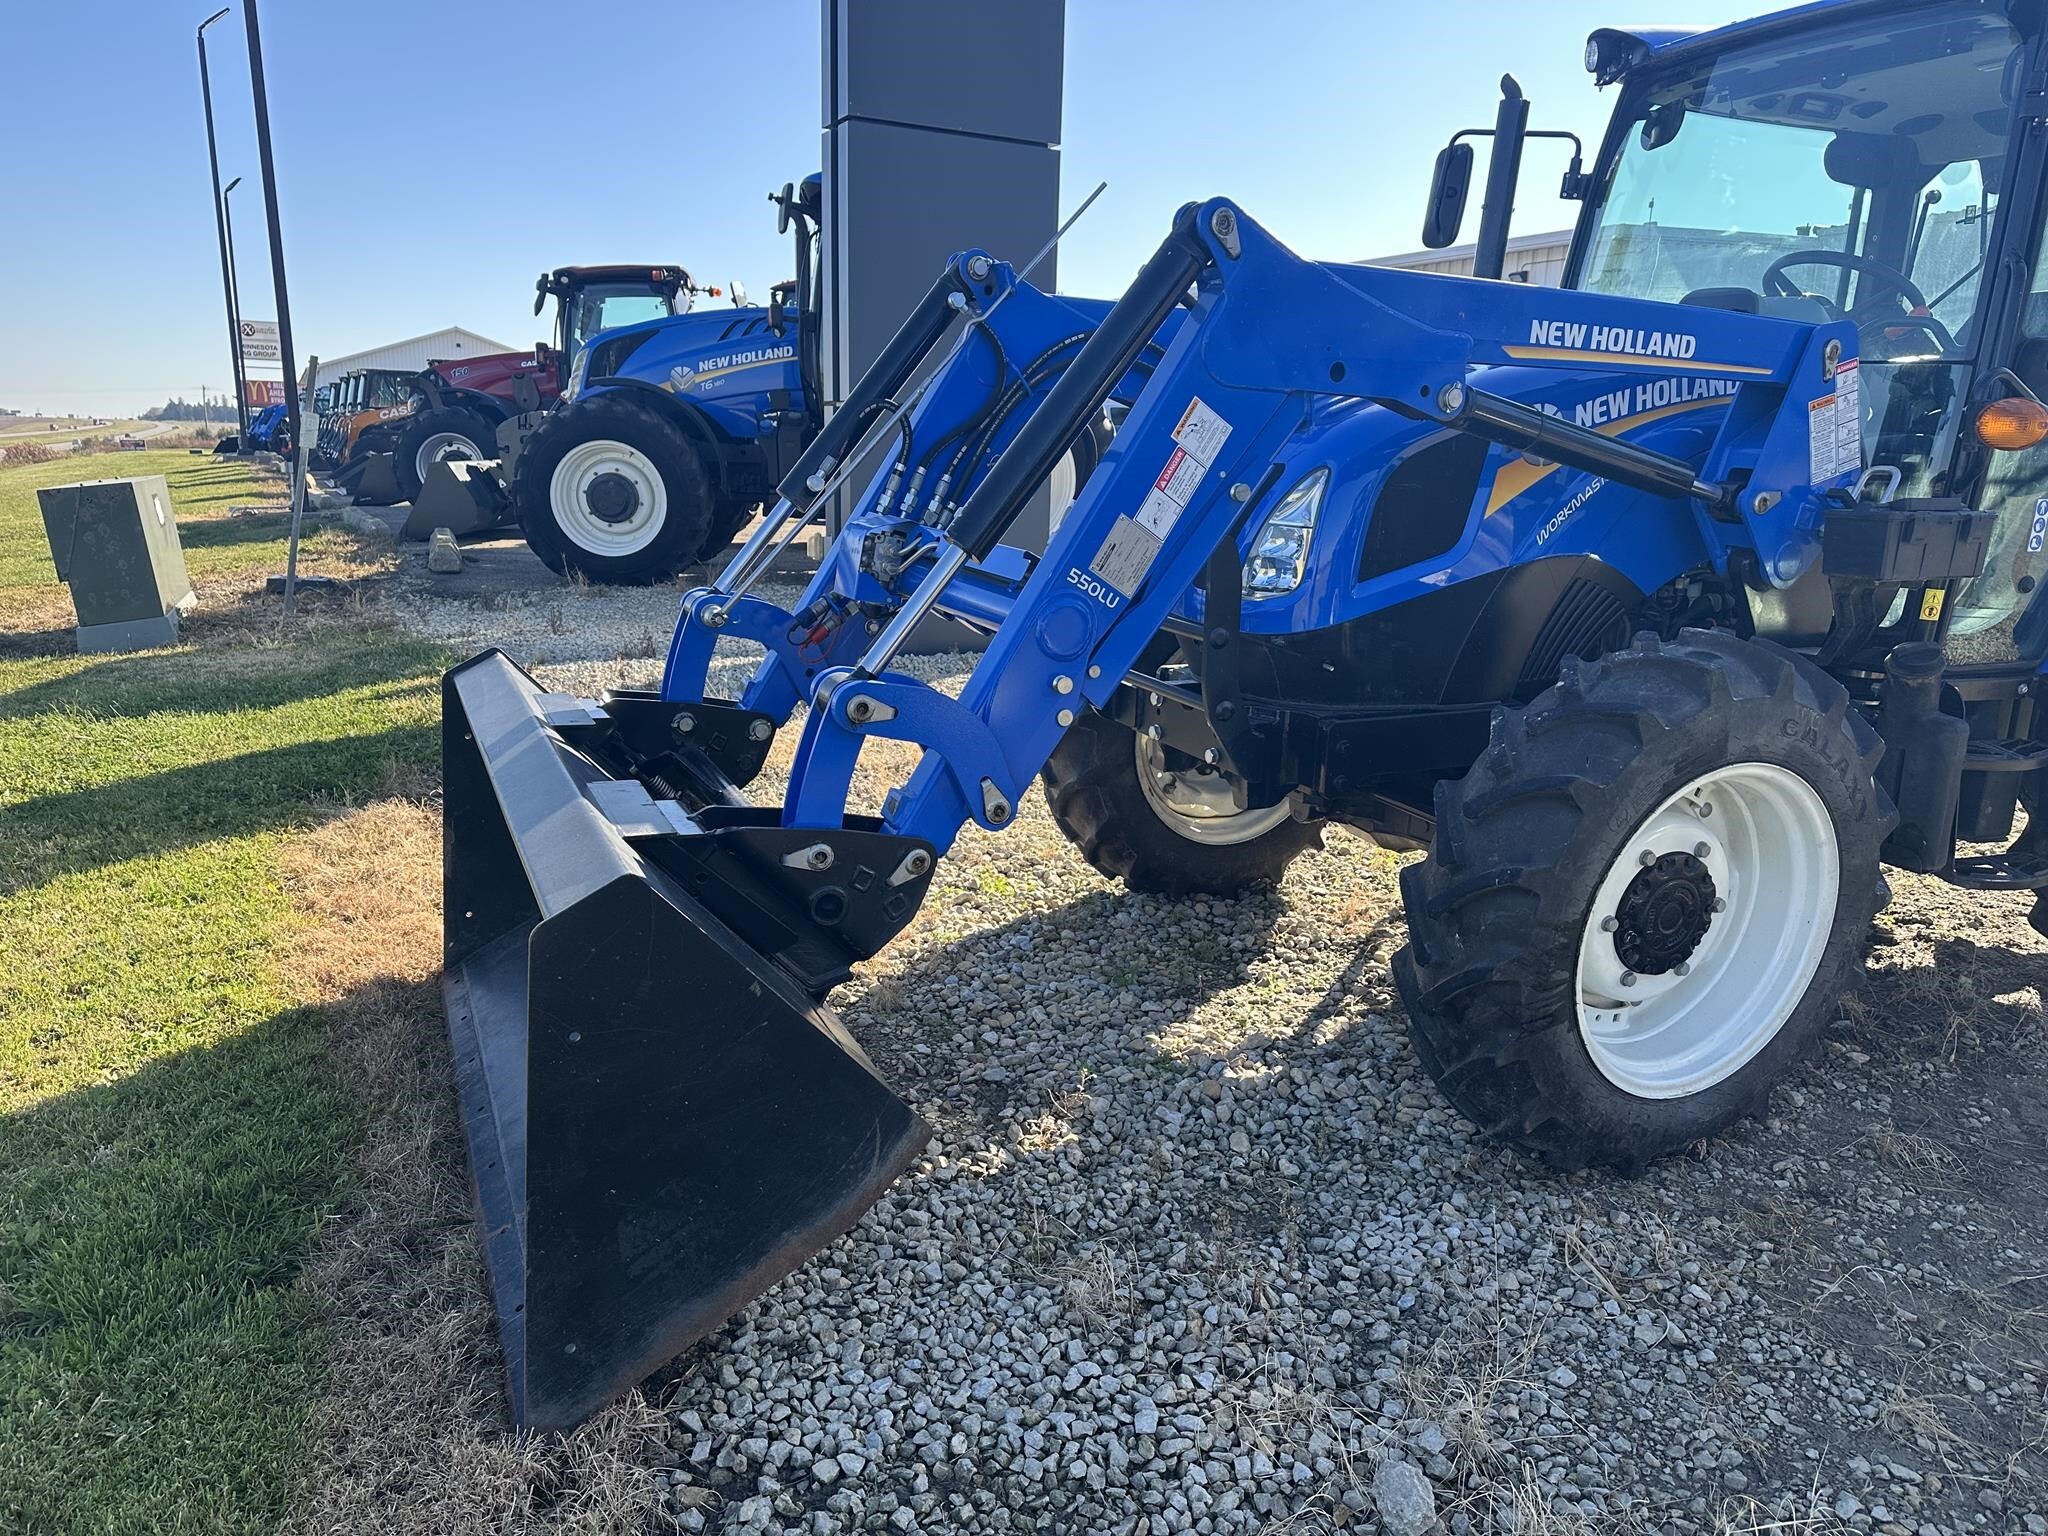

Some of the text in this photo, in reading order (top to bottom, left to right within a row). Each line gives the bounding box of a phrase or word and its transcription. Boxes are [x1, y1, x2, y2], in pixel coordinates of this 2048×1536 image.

[1529, 319, 1697, 359] NEW HOLLAND
[698, 346, 793, 373] NEW HOLLAND
[272, 382, 285, 390] MIL
[1575, 376, 1741, 428] NEW HOLLAND
[1162, 450, 1185, 481] DANGER
[1536, 476, 1610, 546] WORKMAST
[1067, 567, 1120, 609] 550LU
